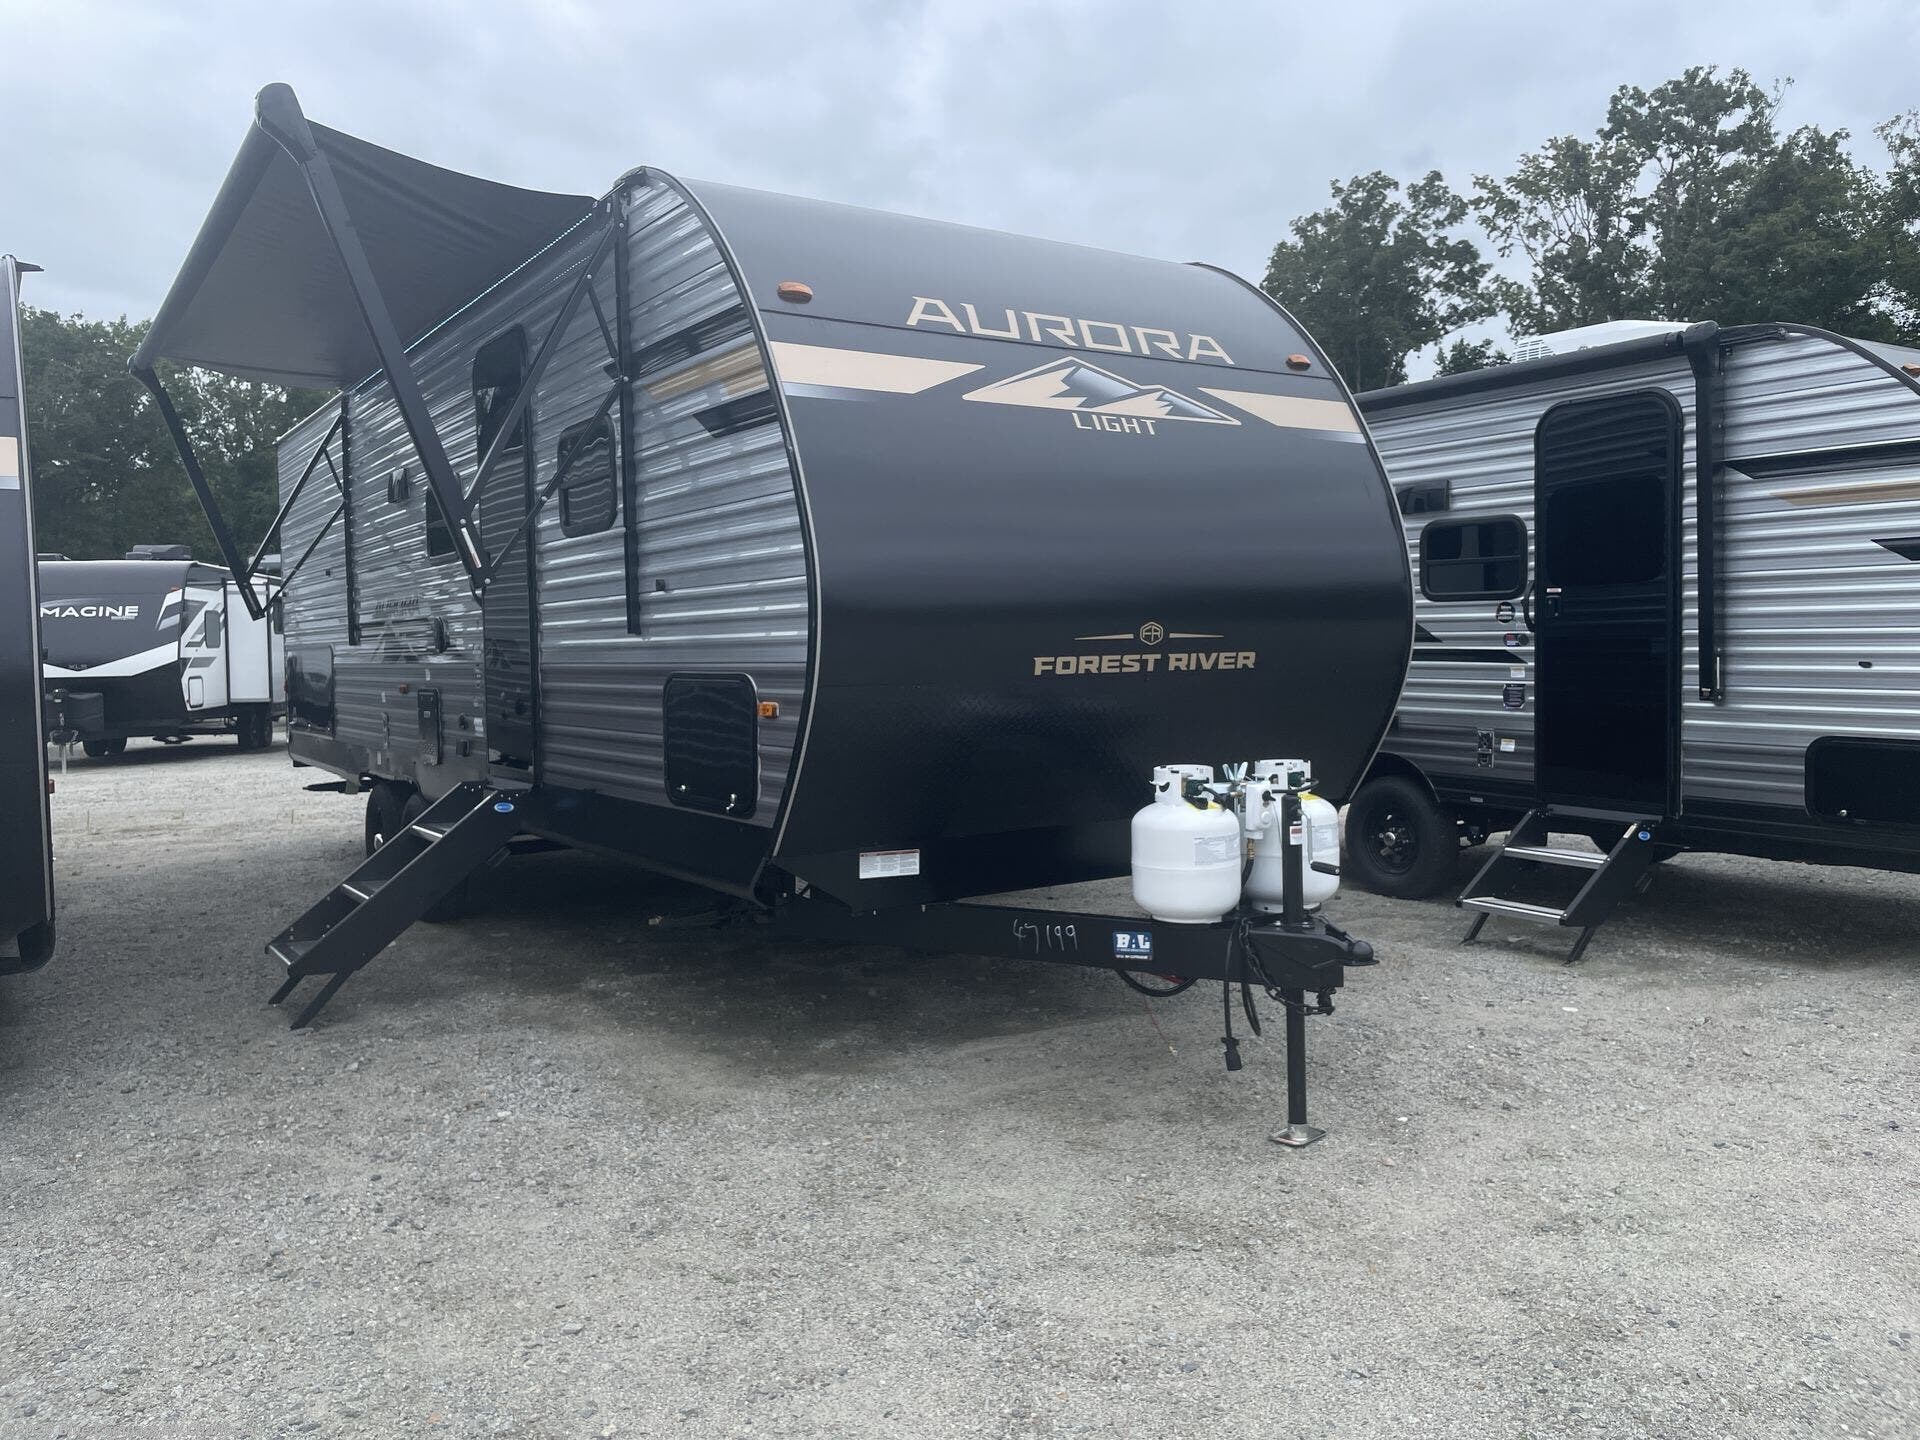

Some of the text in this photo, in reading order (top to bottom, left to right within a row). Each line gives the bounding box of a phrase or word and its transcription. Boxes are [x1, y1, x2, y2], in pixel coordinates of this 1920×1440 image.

[906, 296, 1235, 365] AURORA
[1072, 412, 1156, 435] LIGHT
[40, 605, 139, 618] MAGINE
[1033, 651, 1256, 676] FOREST RIVER
